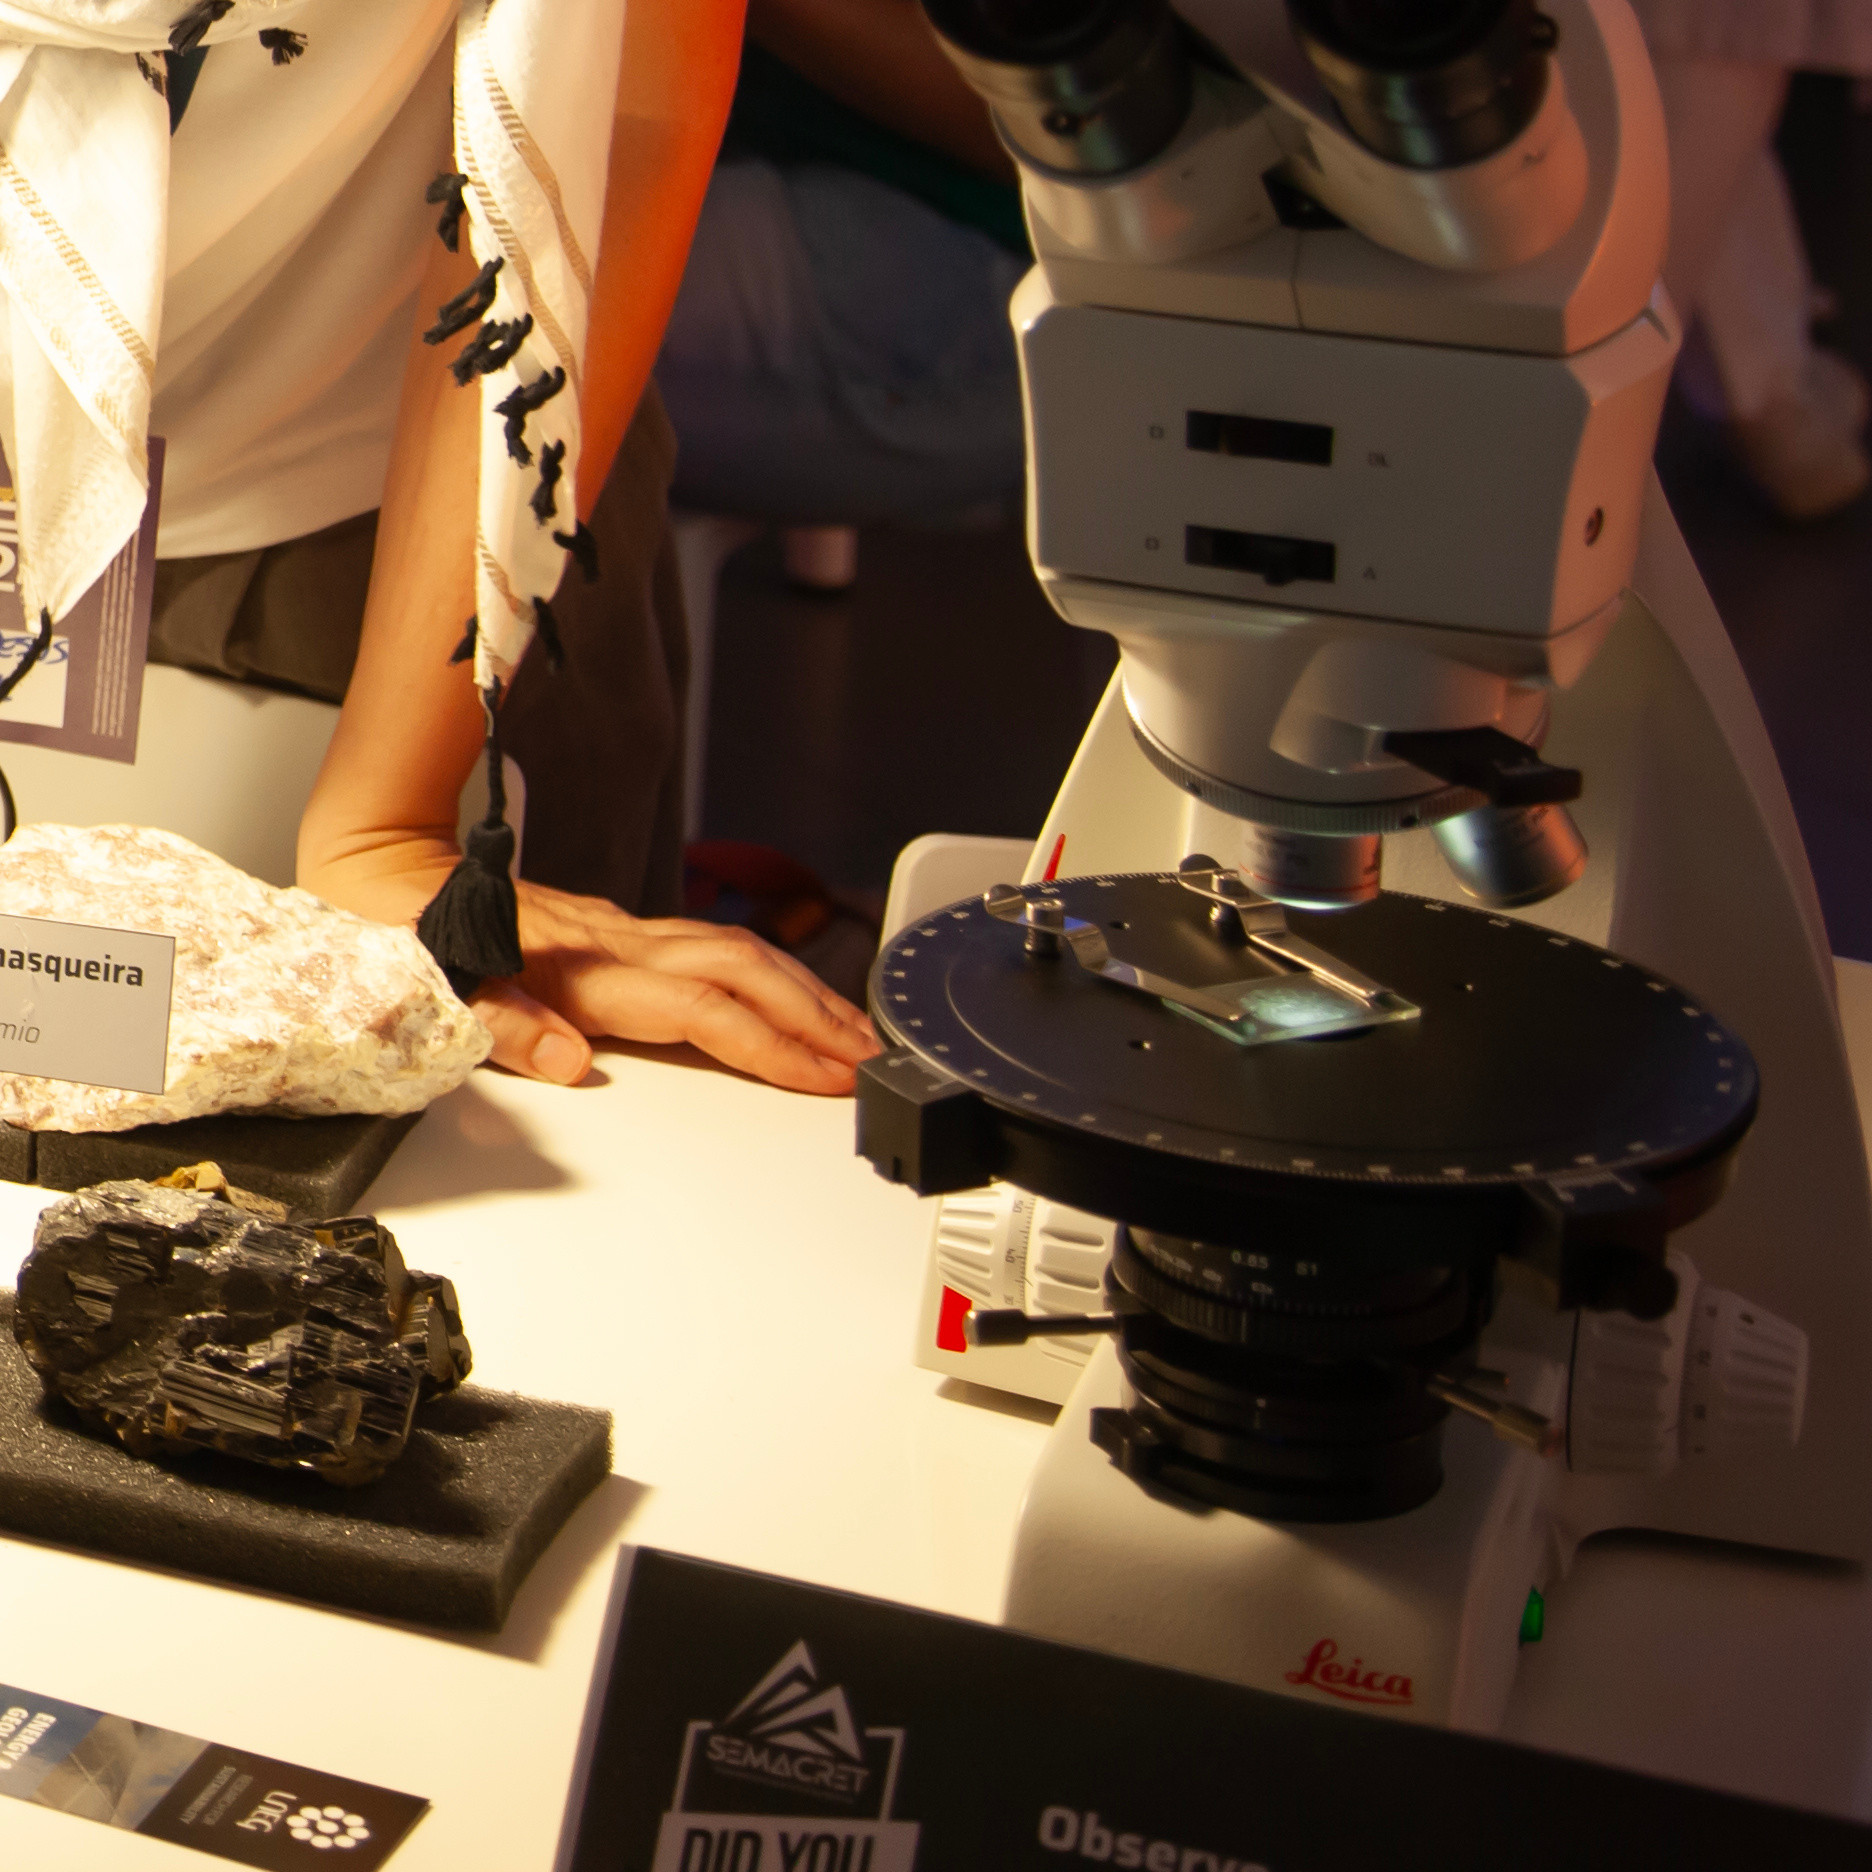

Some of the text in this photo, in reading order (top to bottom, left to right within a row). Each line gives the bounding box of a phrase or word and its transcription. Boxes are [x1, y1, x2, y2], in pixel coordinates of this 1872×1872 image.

[1284, 1638, 1413, 1705] Leica
[1, 1711, 57, 1761] ENERGY
[707, 1734, 871, 1793] SEMACRET
